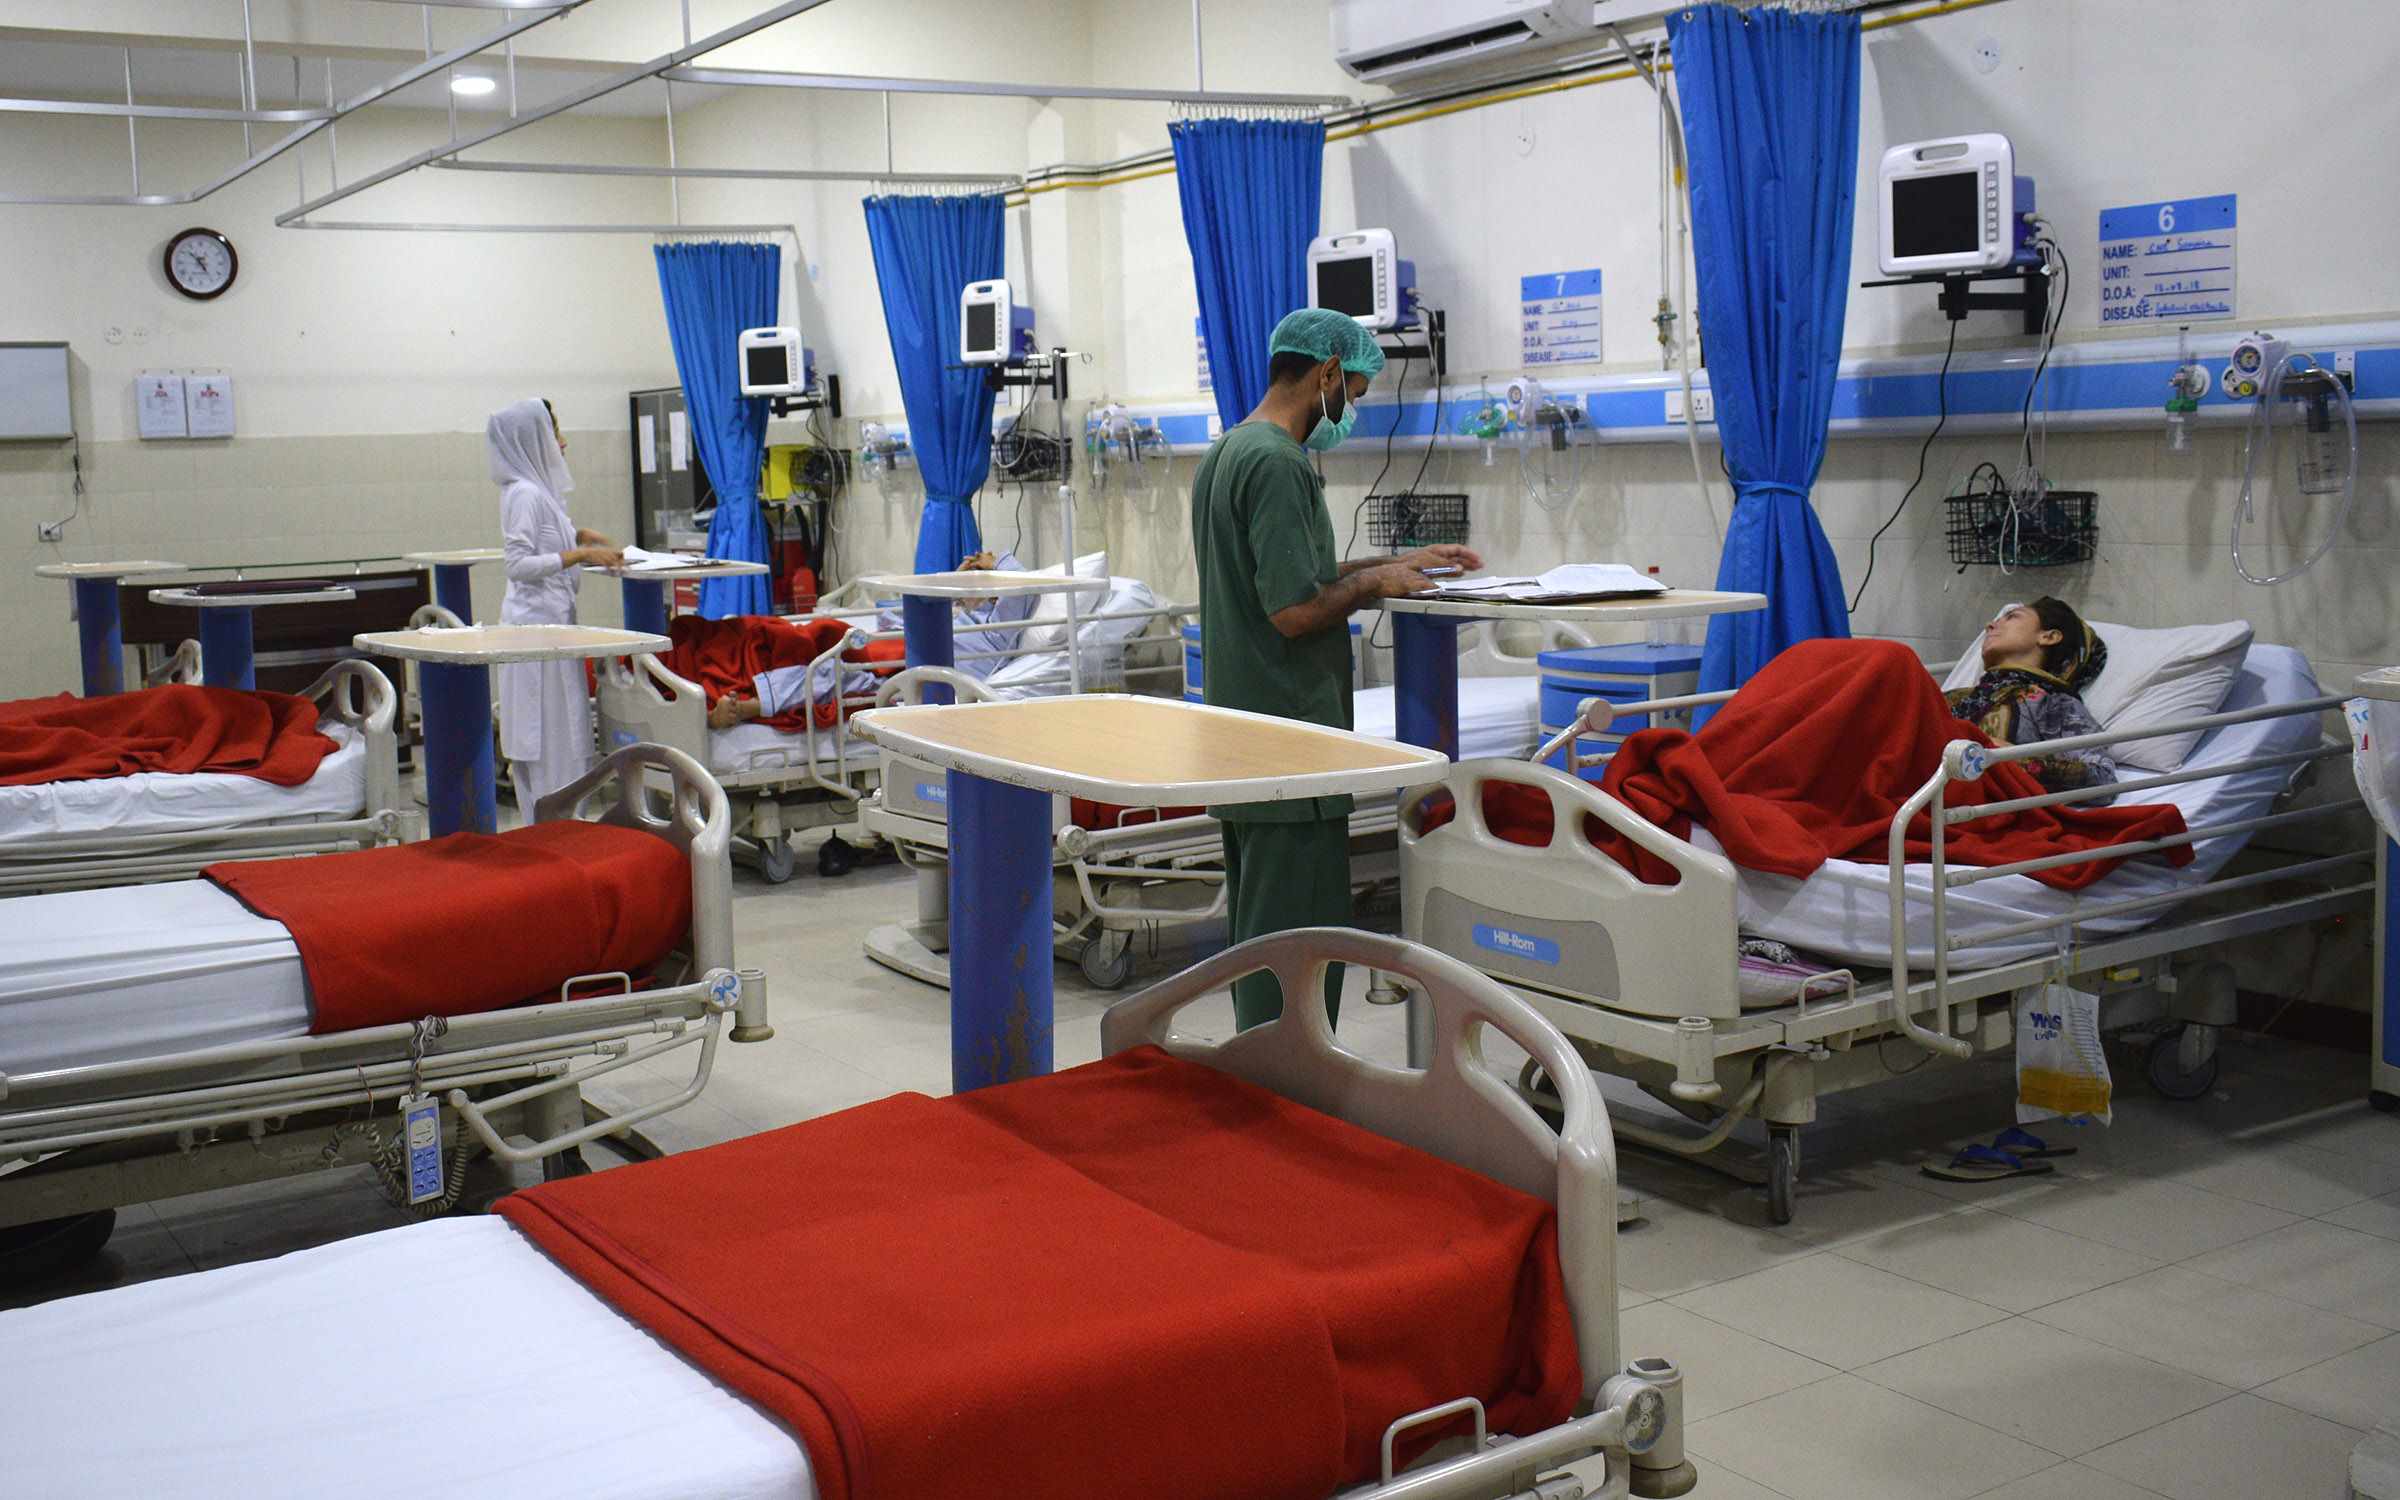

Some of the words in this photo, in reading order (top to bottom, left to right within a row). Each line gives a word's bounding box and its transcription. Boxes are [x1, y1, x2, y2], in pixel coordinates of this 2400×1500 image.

[2158, 204, 2175, 232] 6
[2103, 244, 2138, 260] NAME:
[2103, 265, 2130, 281] UNIT:
[1555, 274, 1567, 297] 7
[2103, 285, 2136, 301] D.O.A:
[2103, 303, 2154, 321] DISEASE:
[1493, 928, 1535, 953] Hill-Rom
